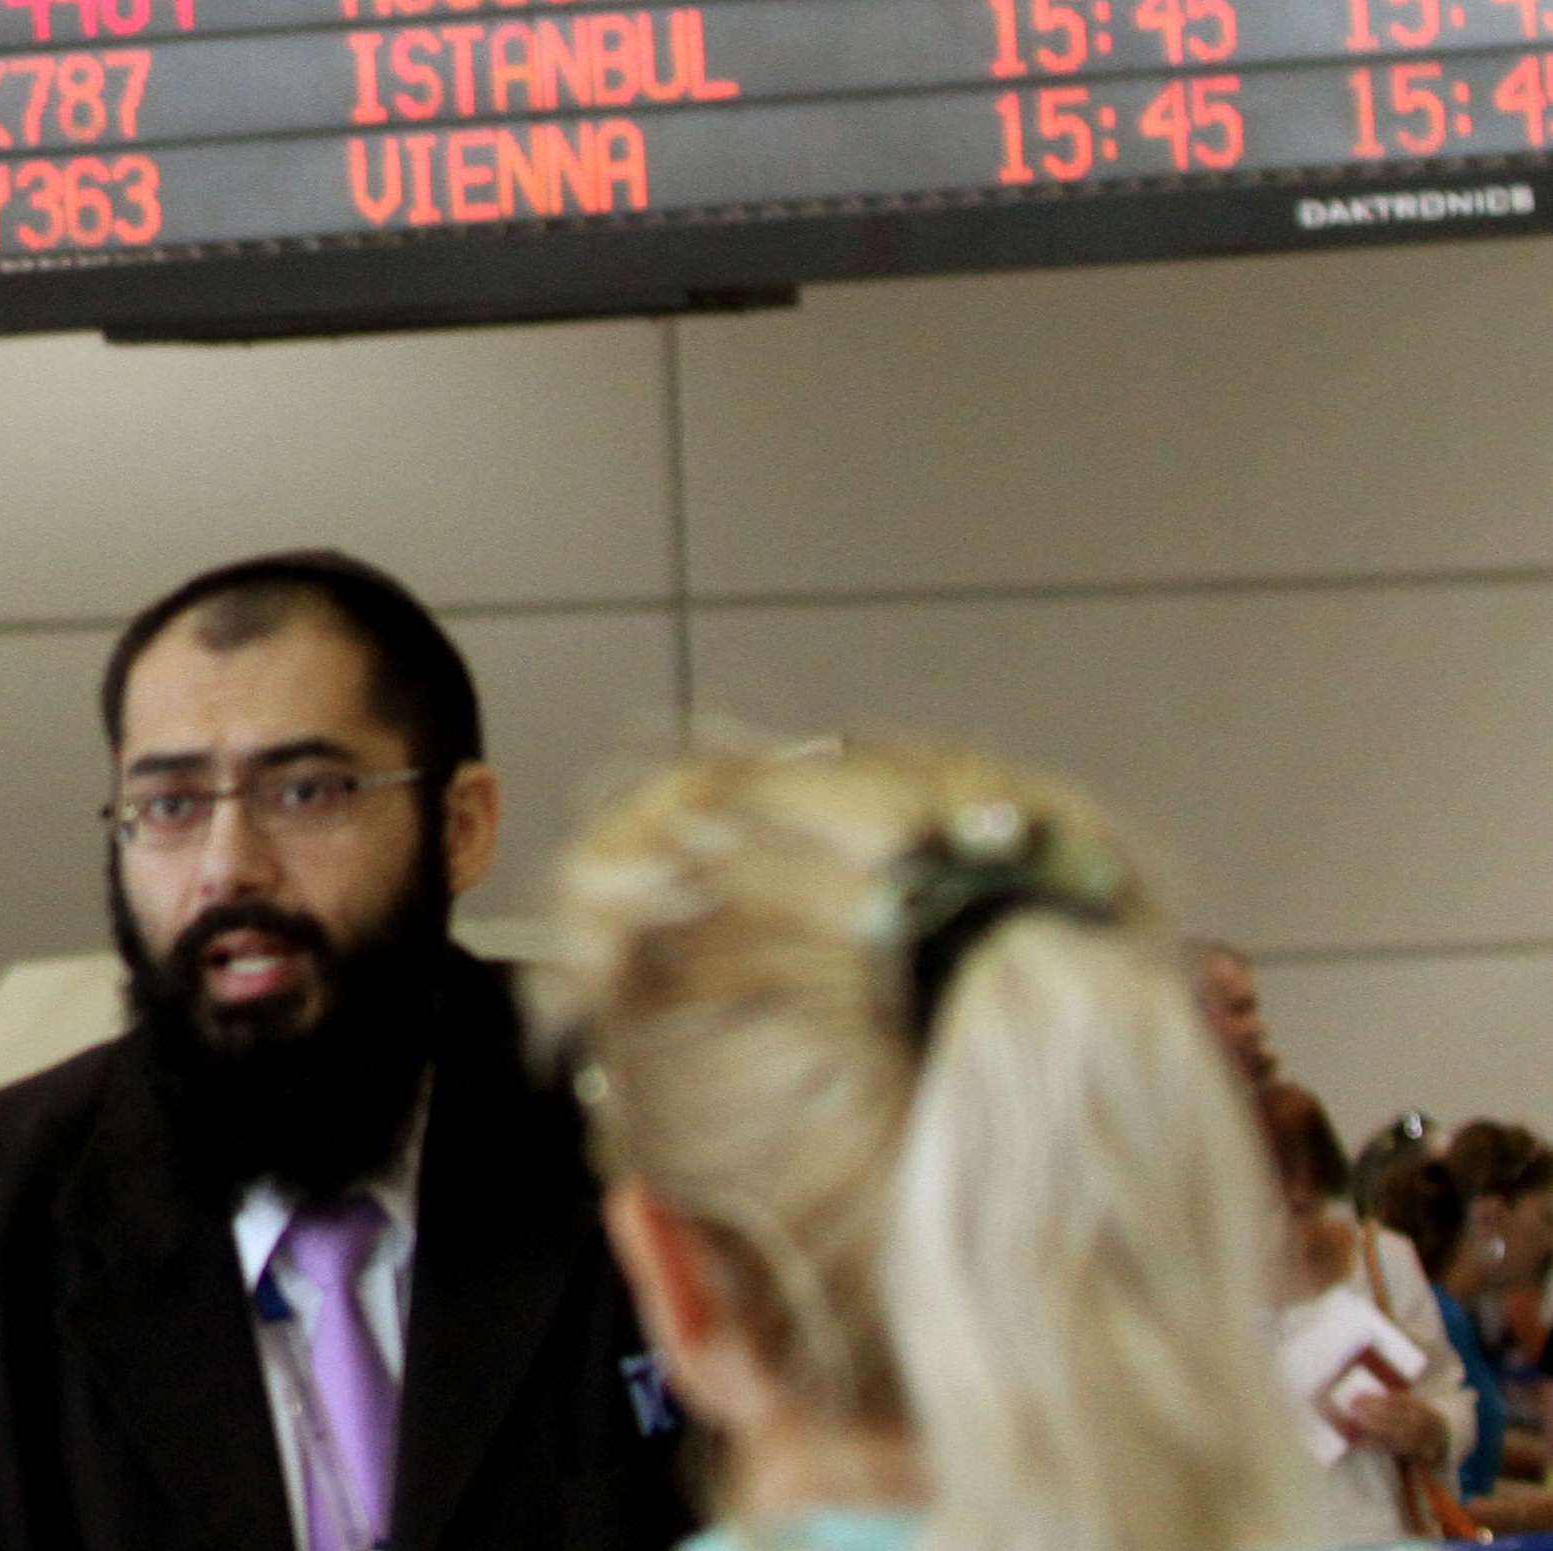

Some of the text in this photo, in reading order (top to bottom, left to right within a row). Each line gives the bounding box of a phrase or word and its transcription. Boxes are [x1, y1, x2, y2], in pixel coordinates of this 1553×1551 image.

[350, 9, 740, 124] ISTANBUL
[350, 119, 649, 225] VIENNA
[997, 76, 1245, 183] 15:45
[1295, 184, 1536, 230] DAKTRONICS
